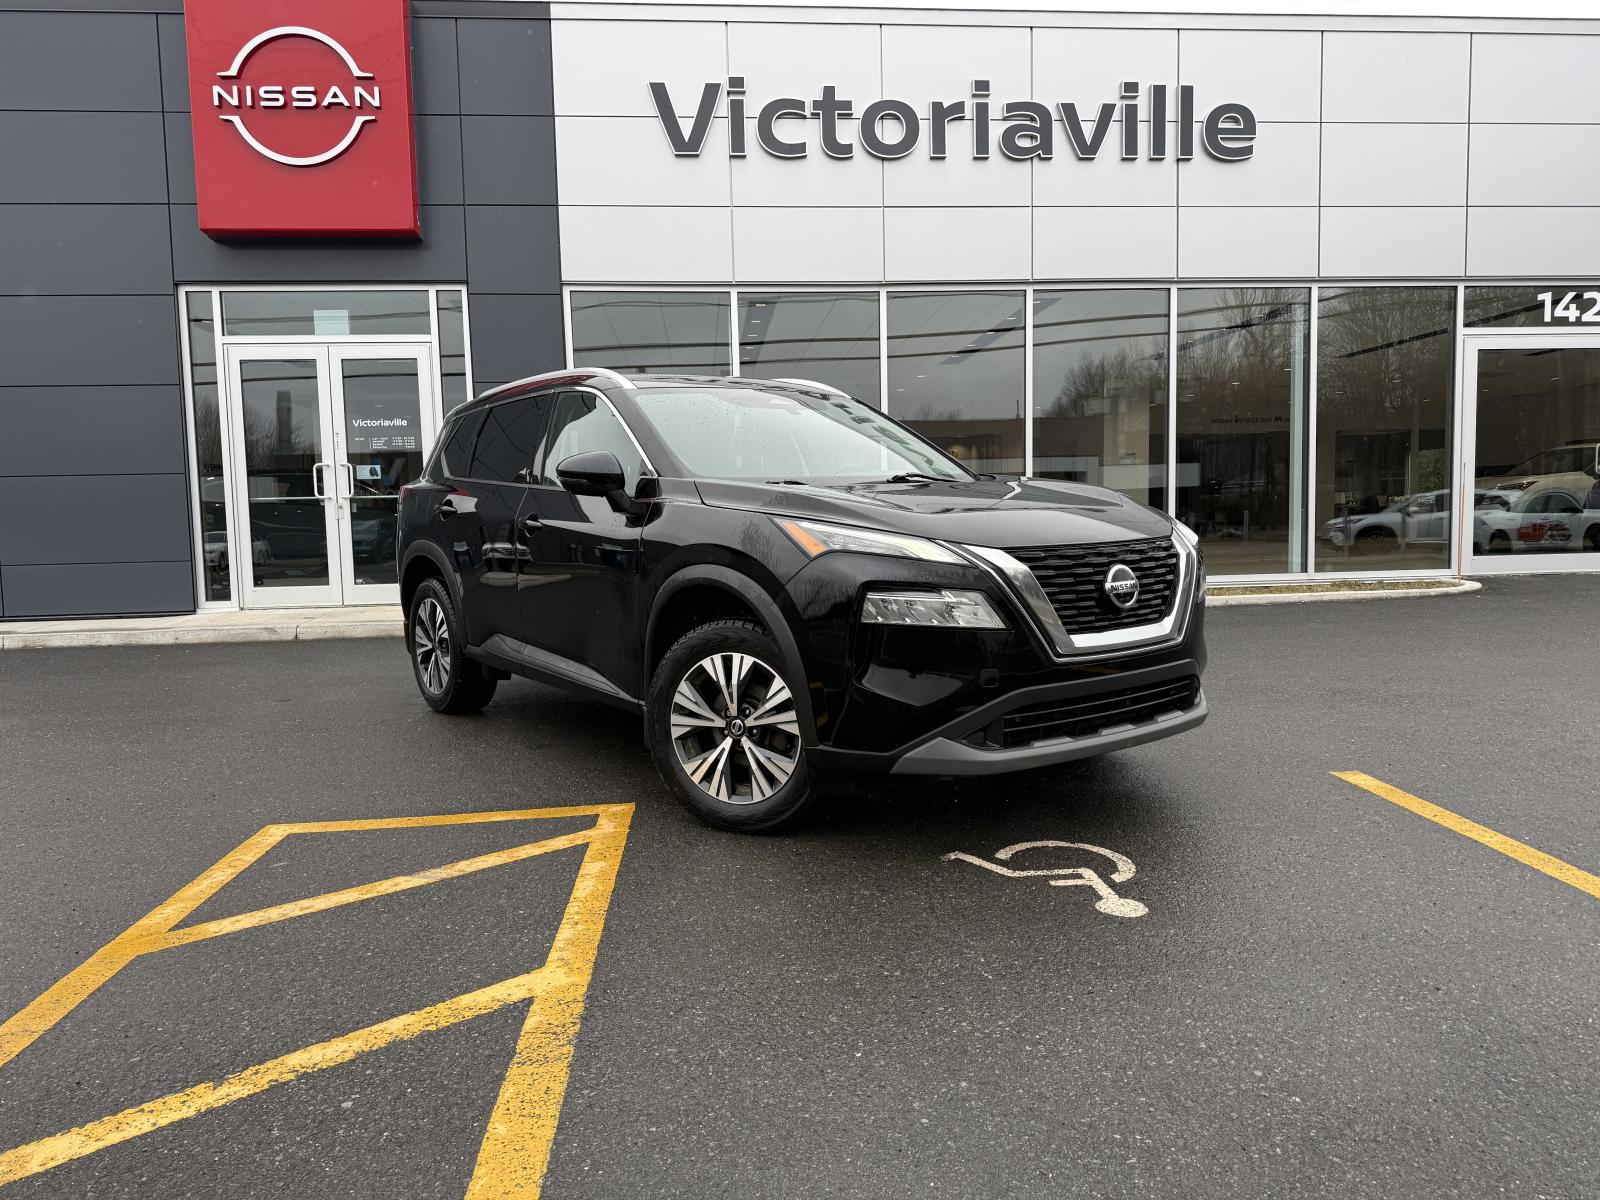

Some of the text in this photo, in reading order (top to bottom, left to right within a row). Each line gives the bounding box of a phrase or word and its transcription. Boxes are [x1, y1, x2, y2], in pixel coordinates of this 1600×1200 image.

[212, 85, 381, 108] NISSAN
[648, 77, 1258, 162] Victoriaville
[1537, 291, 1600, 322] 142
[352, 418, 408, 427] Victoriaville
[1110, 582, 1138, 592] NISSAN
